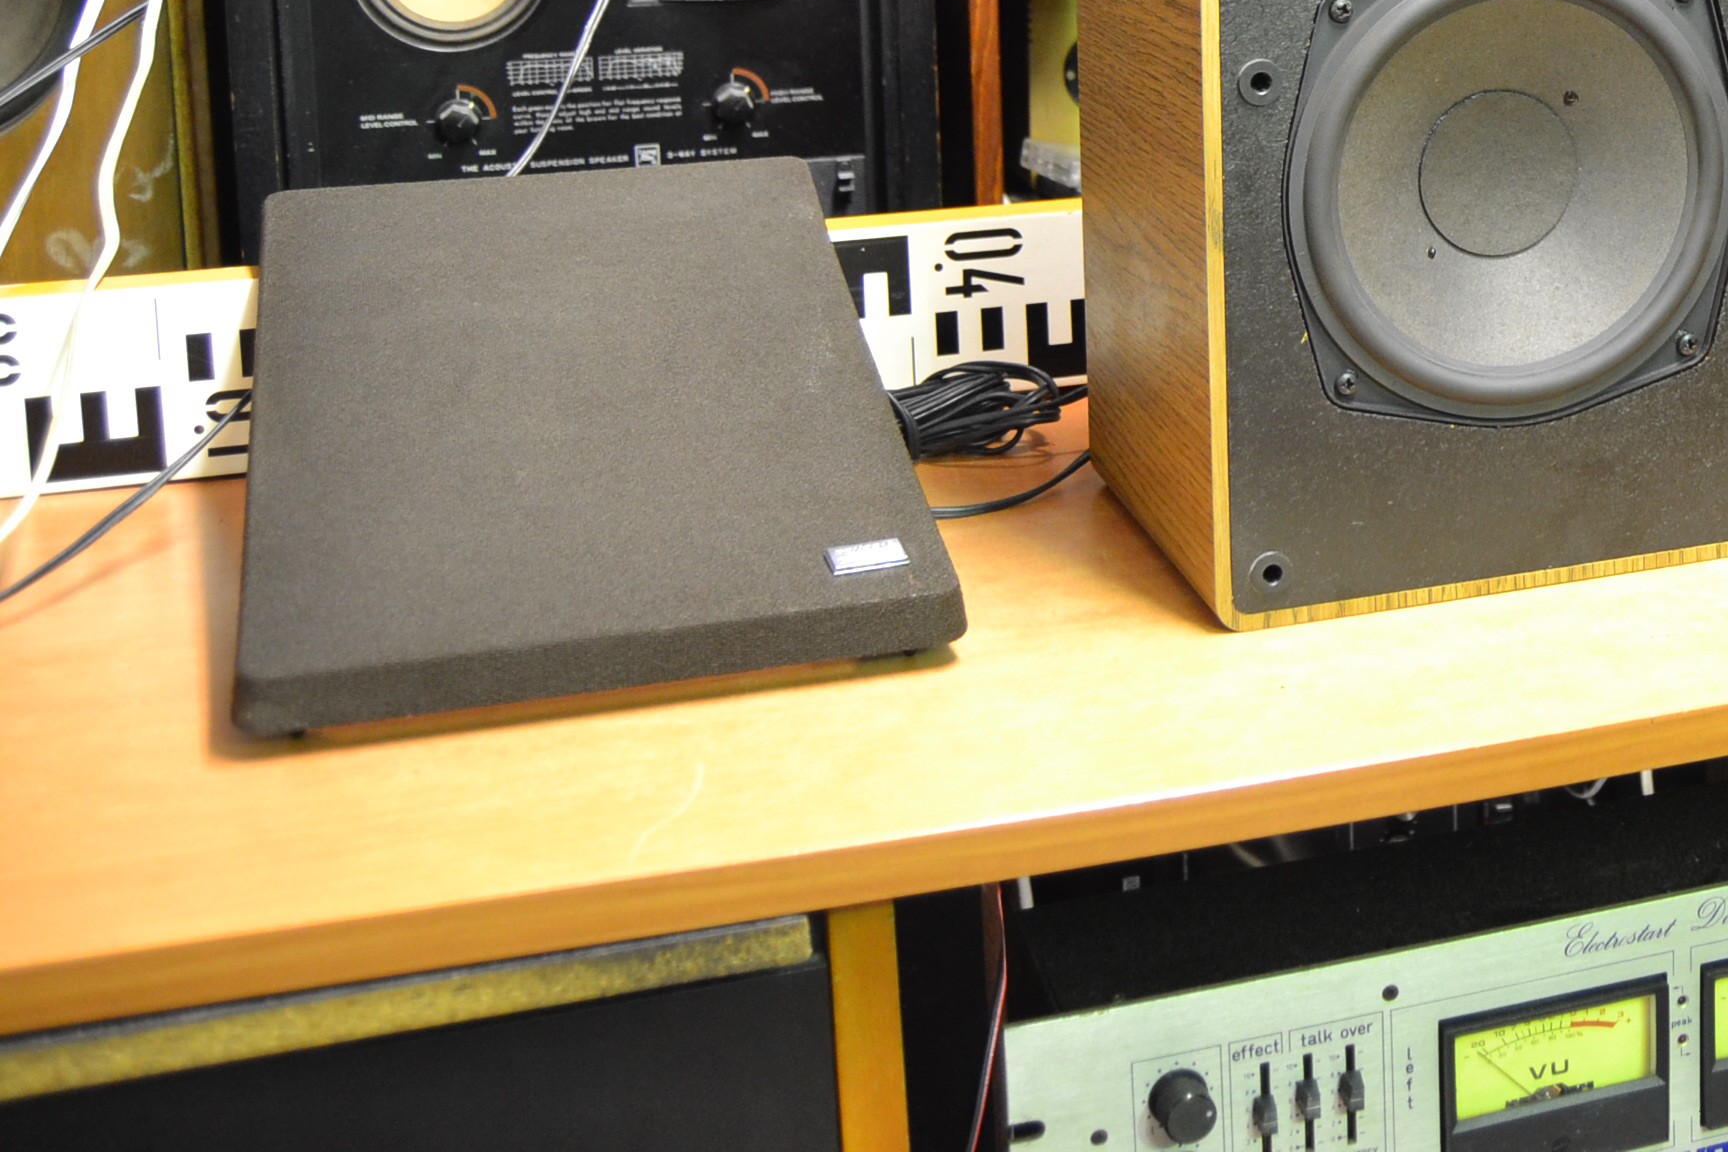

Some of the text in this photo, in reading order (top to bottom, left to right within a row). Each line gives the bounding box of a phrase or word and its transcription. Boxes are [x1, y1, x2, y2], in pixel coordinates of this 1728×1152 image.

[460, 165, 479, 173] THE
[530, 158, 585, 168] SUSPENSION
[588, 155, 629, 164] SPEAKER
[1564, 919, 1677, 958] Electrostart
[1301, 1022, 1373, 1047] talk over
[1671, 1018, 1692, 1029] peak
[1232, 1039, 1279, 1062] effect
[1529, 1059, 1569, 1080] VU
